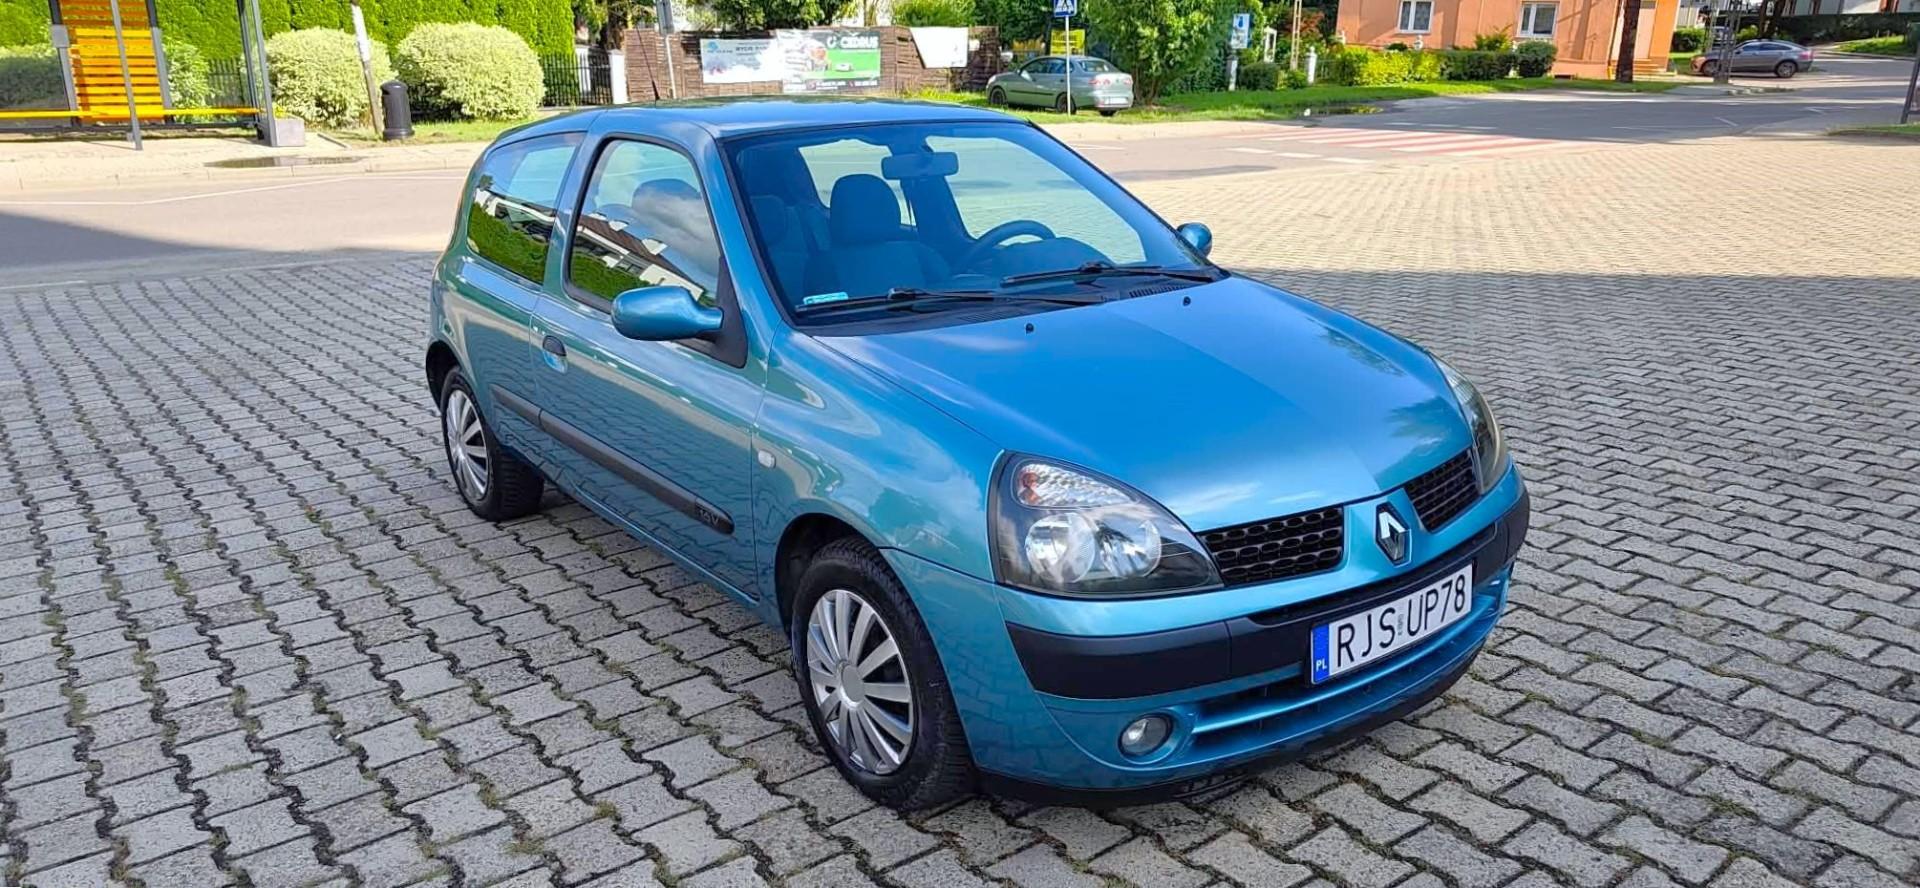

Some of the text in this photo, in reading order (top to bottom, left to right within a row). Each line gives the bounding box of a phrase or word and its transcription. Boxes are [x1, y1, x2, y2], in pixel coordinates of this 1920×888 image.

[1337, 574, 1466, 668] RJS UP78
[1316, 660, 1328, 671] PL
